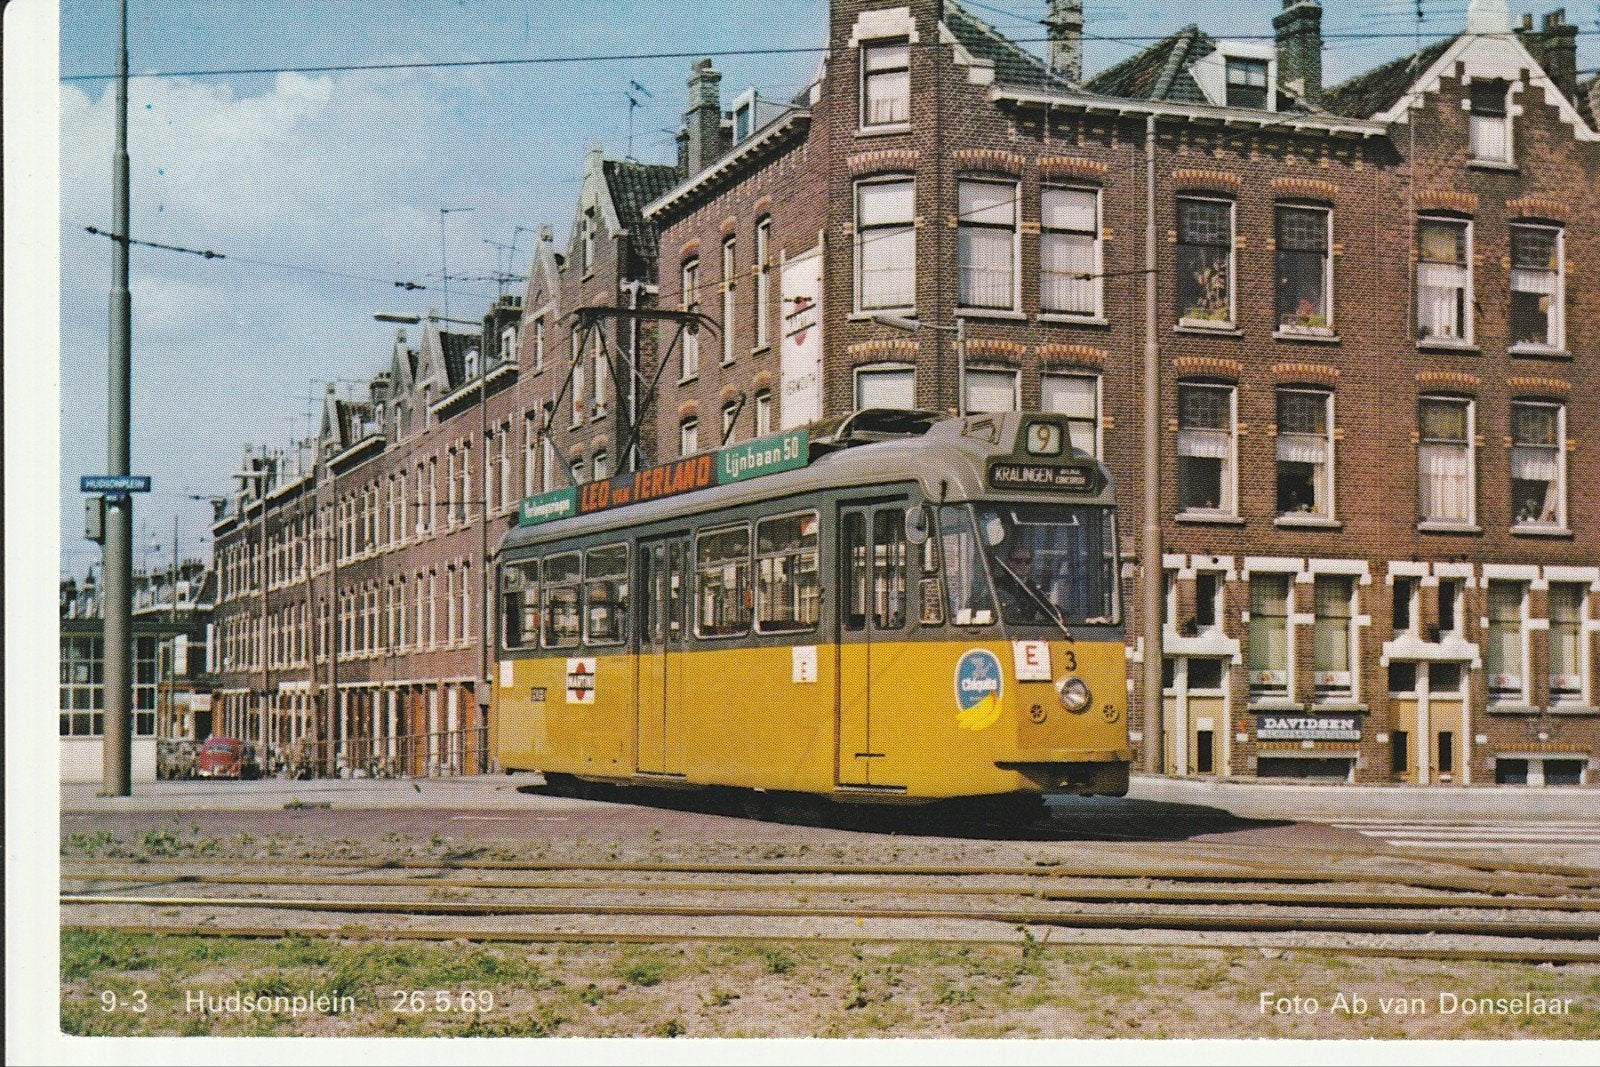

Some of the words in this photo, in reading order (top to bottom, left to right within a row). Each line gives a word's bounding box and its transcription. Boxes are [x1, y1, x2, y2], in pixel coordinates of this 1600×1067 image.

[1037, 425, 1050, 451] 9
[783, 436, 799, 461] 50
[581, 481, 610, 512] LEO
[634, 457, 711, 500] IERLAND
[995, 467, 1053, 483] KRALINGEN
[1025, 645, 1038, 665] E
[1065, 651, 1077, 671] 3
[1264, 718, 1355, 730] DAVIDSEN
